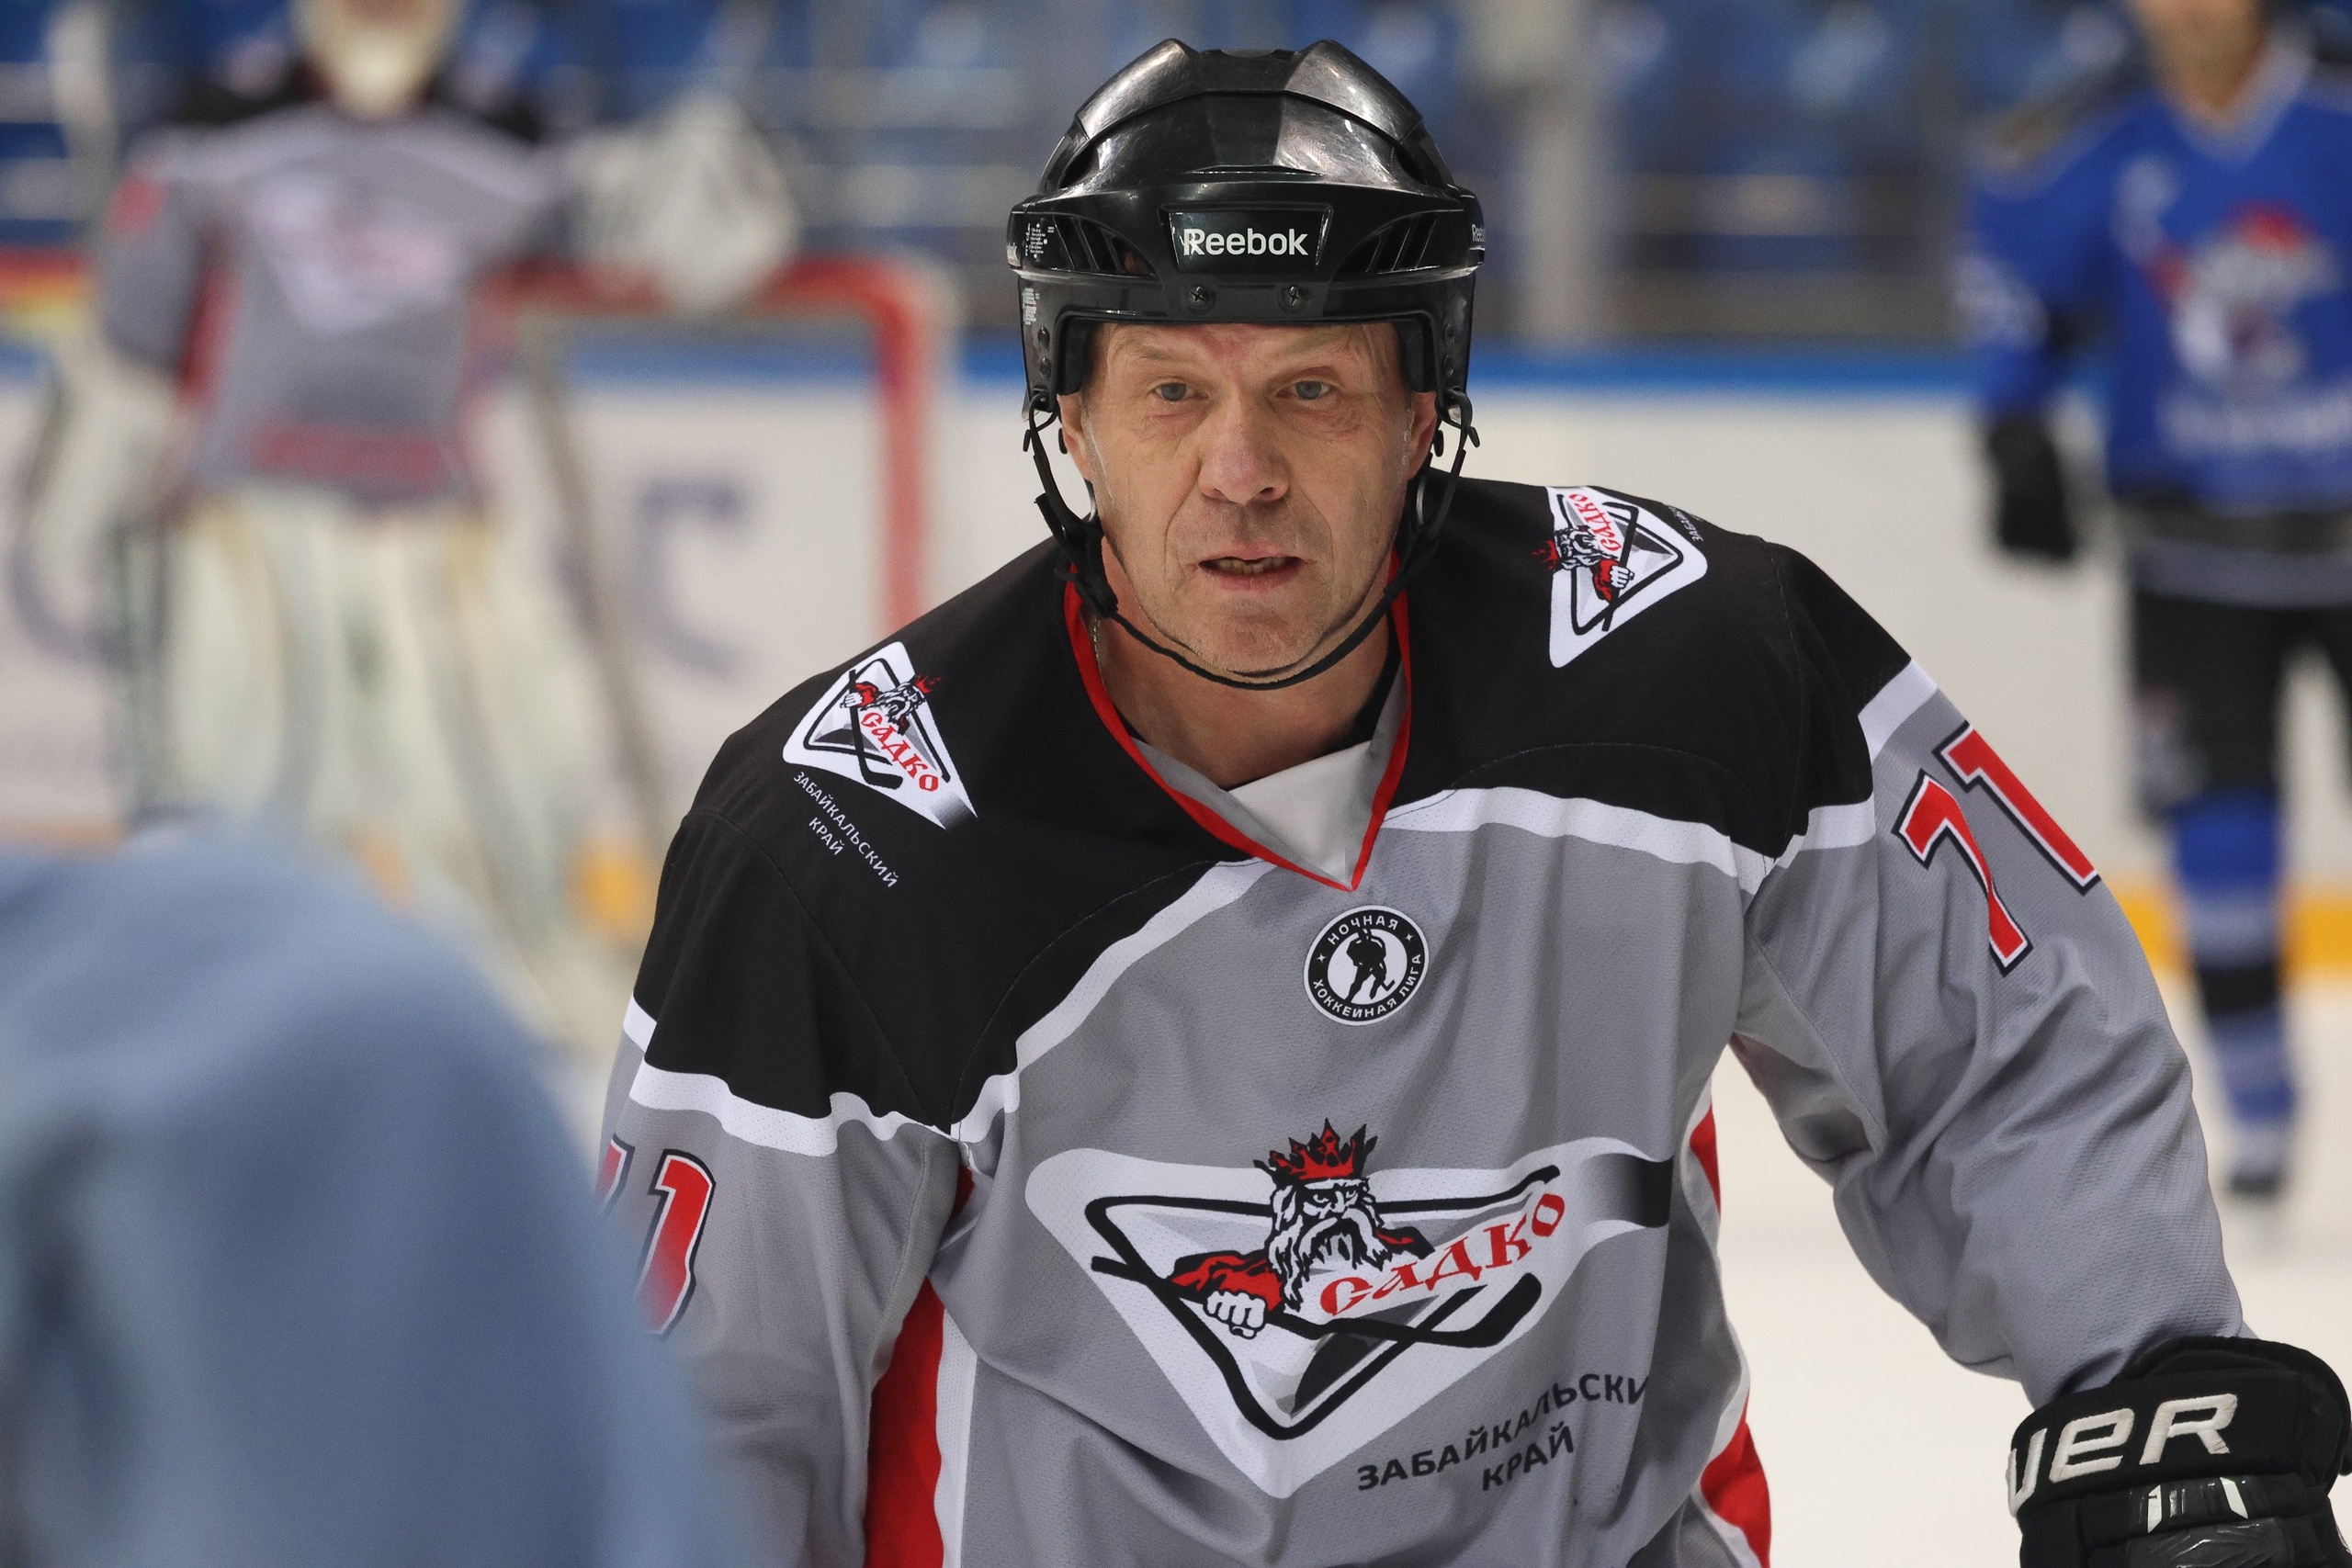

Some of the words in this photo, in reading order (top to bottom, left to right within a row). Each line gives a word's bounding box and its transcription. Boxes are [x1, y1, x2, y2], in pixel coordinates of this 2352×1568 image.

[1182, 228, 1308, 256] Reebok
[793, 771, 899, 887] ЗАБАЙКАЛЬСКИЙ
[808, 817, 844, 855] КРАЙ
[1891, 719, 2102, 978] 71
[1327, 915, 1399, 945] НОЧНАЯ
[1398, 953, 1422, 998] ЛИГА
[1319, 1192, 1566, 1316] САДКО
[1482, 1421, 1576, 1492] КРАЙ
